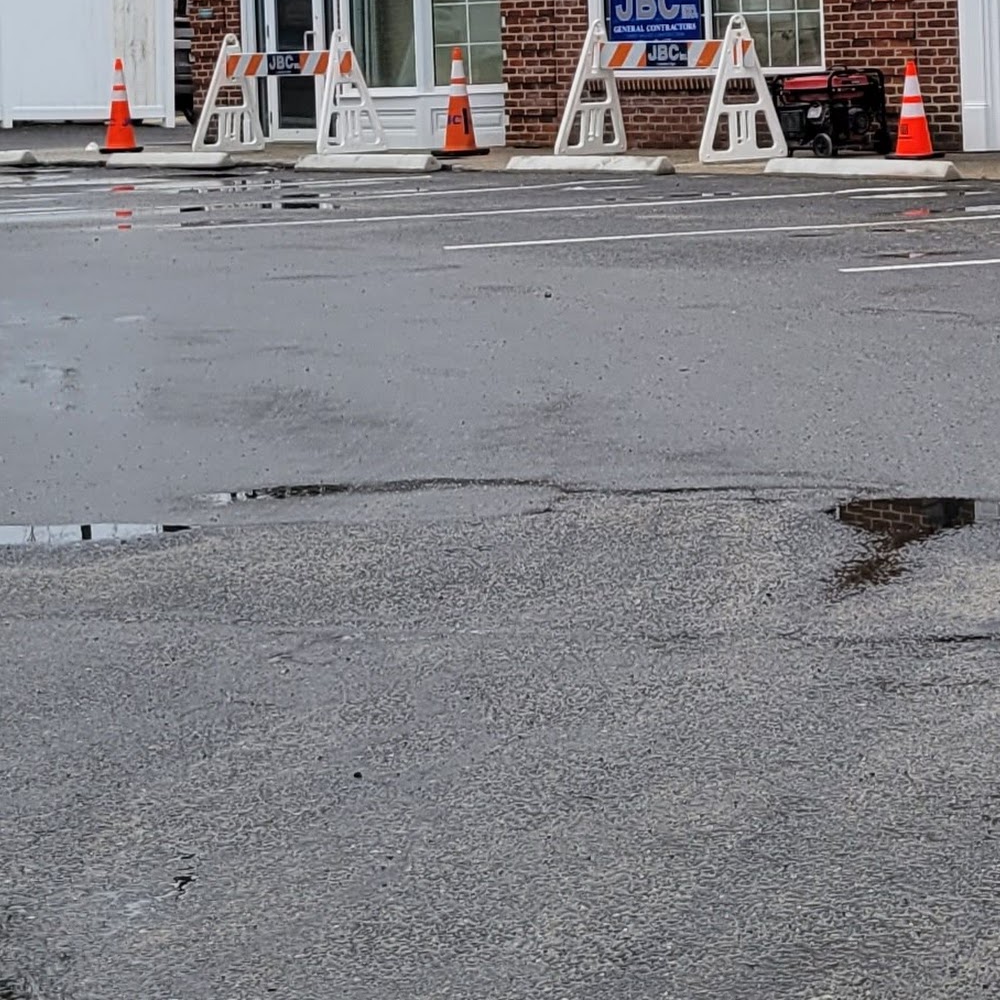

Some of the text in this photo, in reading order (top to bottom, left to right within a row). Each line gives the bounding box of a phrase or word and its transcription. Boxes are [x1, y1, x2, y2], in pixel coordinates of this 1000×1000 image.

[613, 22, 696, 33] GENERAL CONTRACTORS
[647, 44, 679, 61] JBC
[269, 55, 293, 70] JBC
